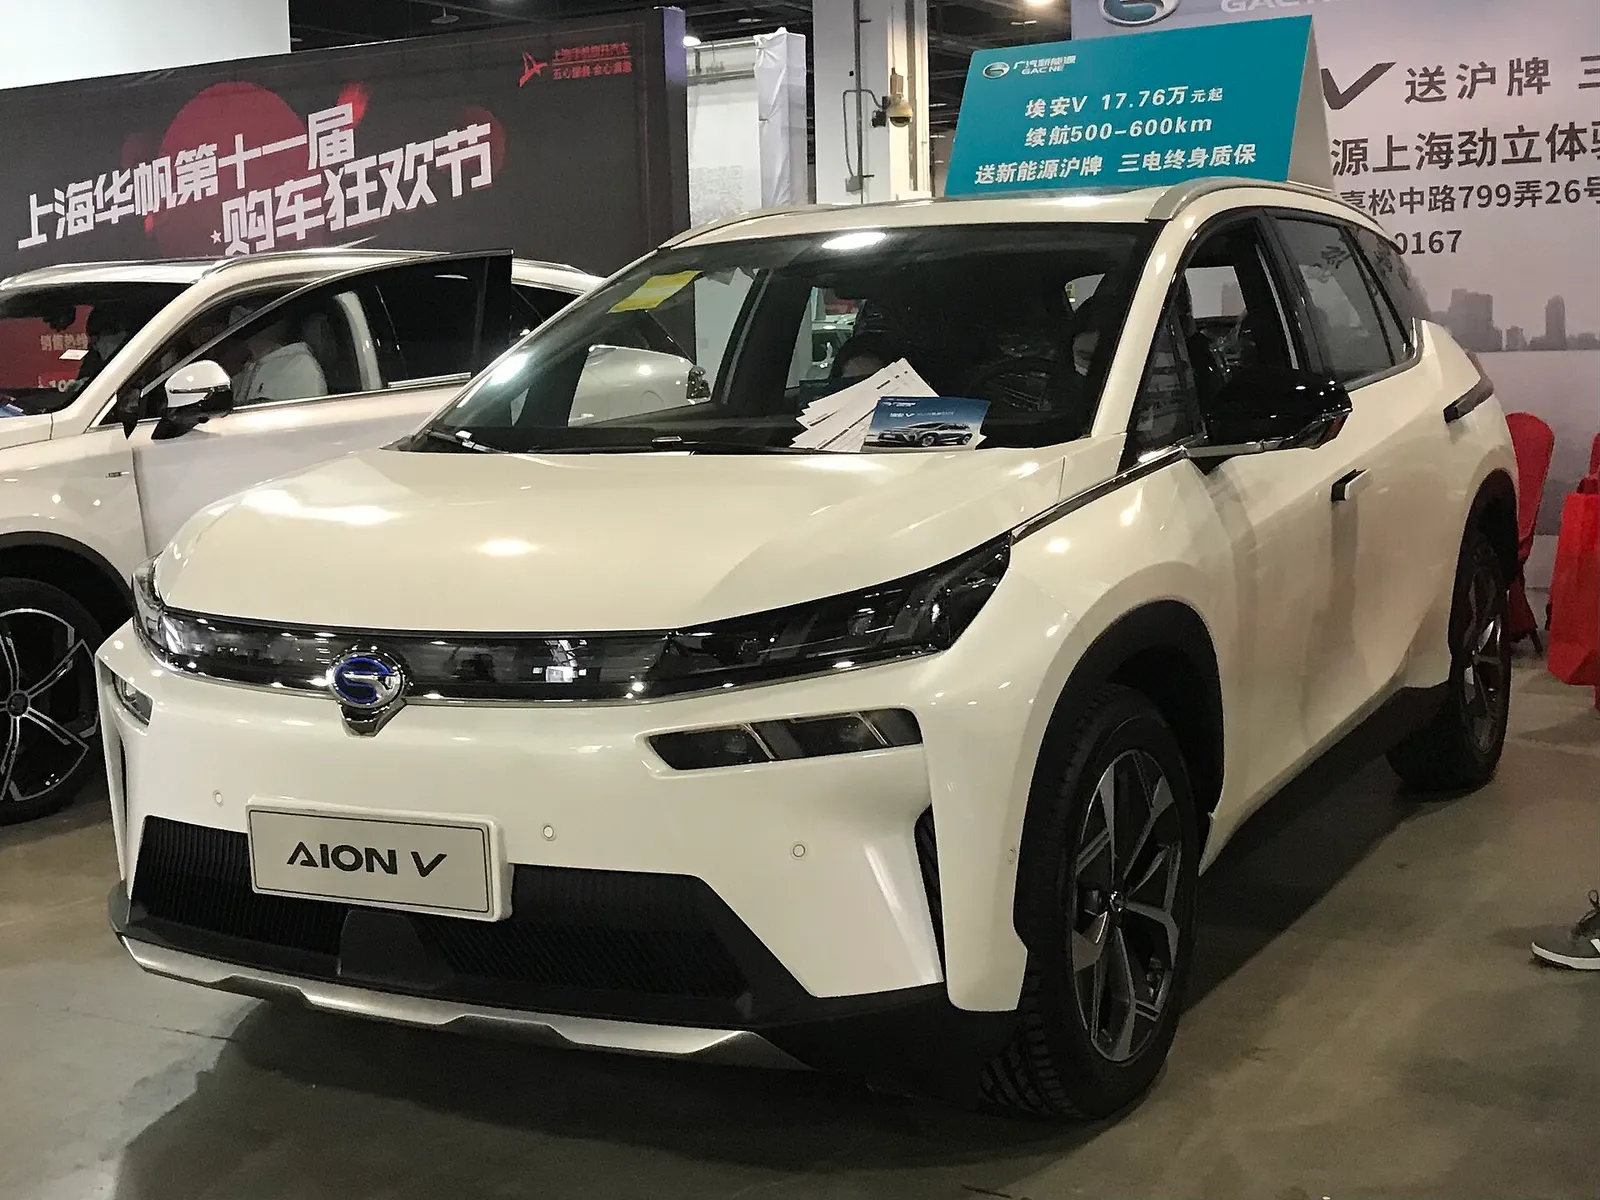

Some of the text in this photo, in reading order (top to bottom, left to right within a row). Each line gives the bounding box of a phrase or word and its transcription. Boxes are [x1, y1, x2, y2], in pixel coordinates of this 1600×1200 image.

[1404, 56, 1551, 105] 送沪牌
[1024, 95, 1087, 119] 埃安V
[1024, 116, 1213, 148] 续航500-600km
[1330, 121, 1600, 177] 源上海劲立体
[18, 102, 355, 250] 上海华帆第十一届
[974, 143, 1256, 185] 送新能源沪牌 三电终身质保
[222, 122, 492, 256] 购车狂欢节
[286, 841, 448, 878] AION V
